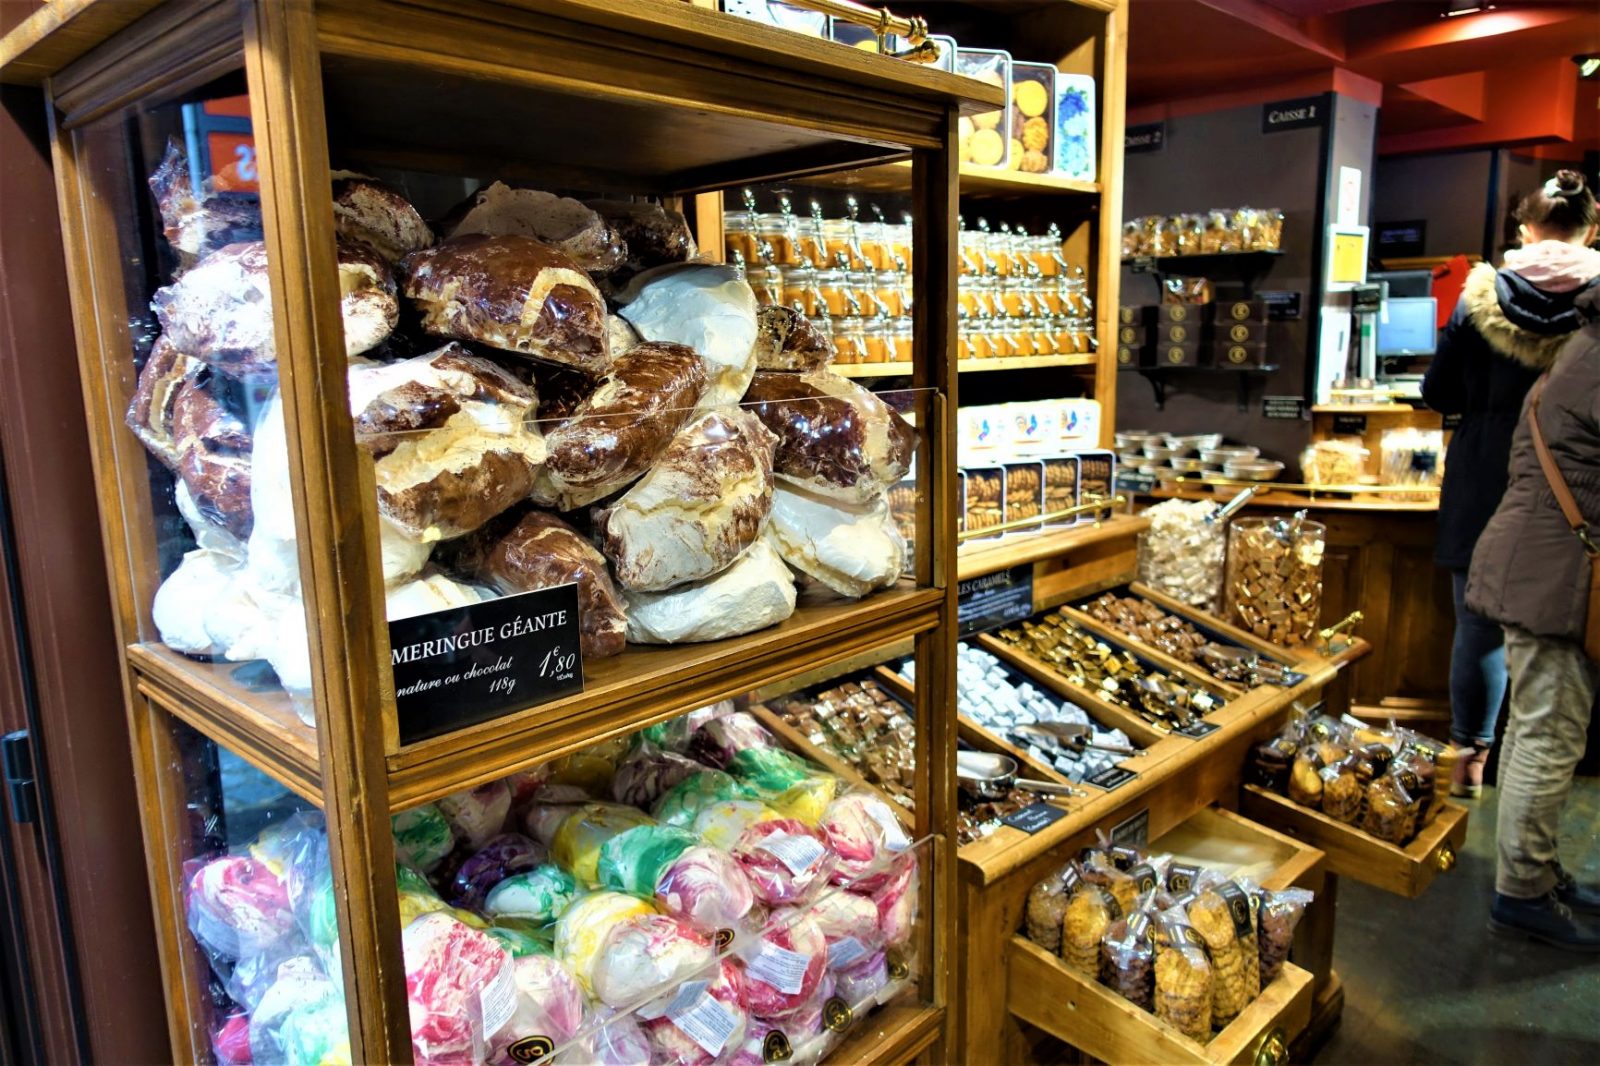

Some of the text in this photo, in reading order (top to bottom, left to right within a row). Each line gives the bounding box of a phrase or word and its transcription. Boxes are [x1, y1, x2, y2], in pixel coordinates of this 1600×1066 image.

[391, 610, 567, 665] MERINGUE GÉANTE
[396, 656, 514, 698] nature ou chocolat
[489, 677, 517, 695] 118g
